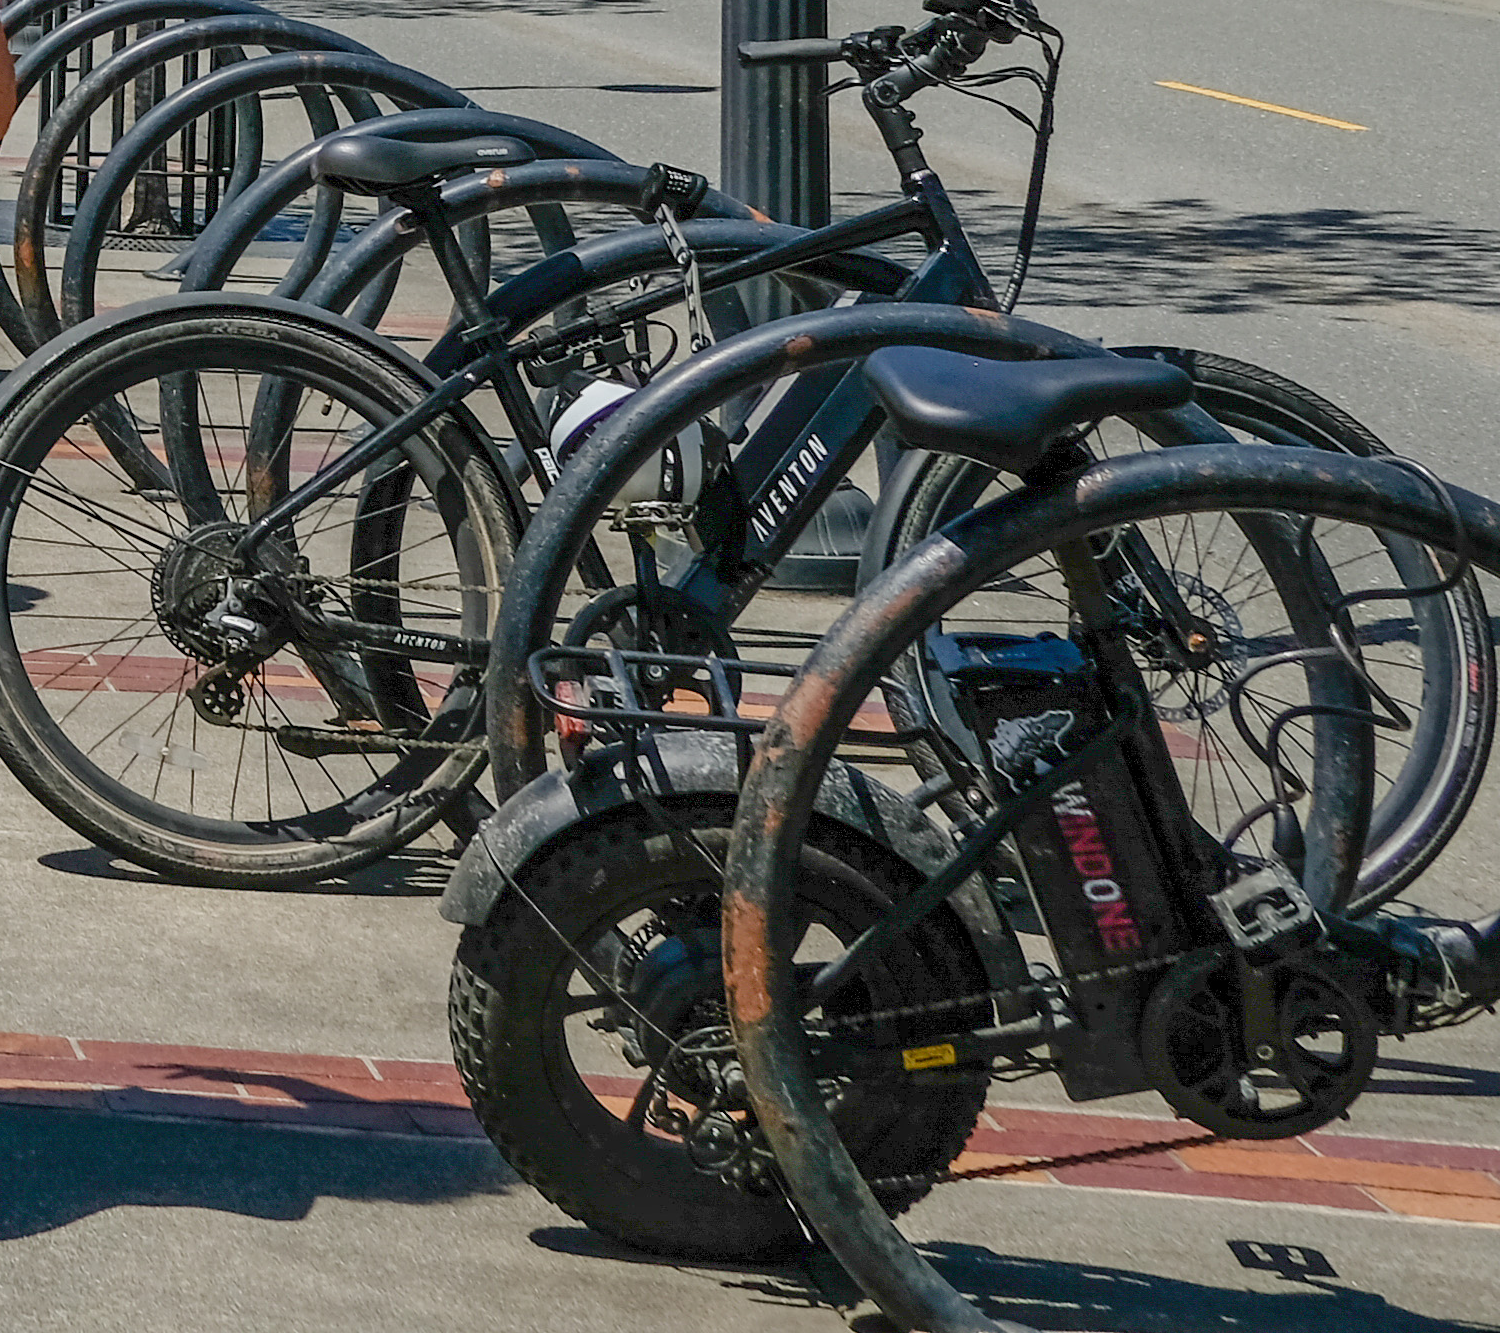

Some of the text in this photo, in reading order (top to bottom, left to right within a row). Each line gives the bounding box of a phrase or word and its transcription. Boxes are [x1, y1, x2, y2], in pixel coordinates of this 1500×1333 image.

[533, 446, 561, 486] pac
[750, 433, 829, 543] AVENTON
[1051, 781, 1143, 953] WINDONE
